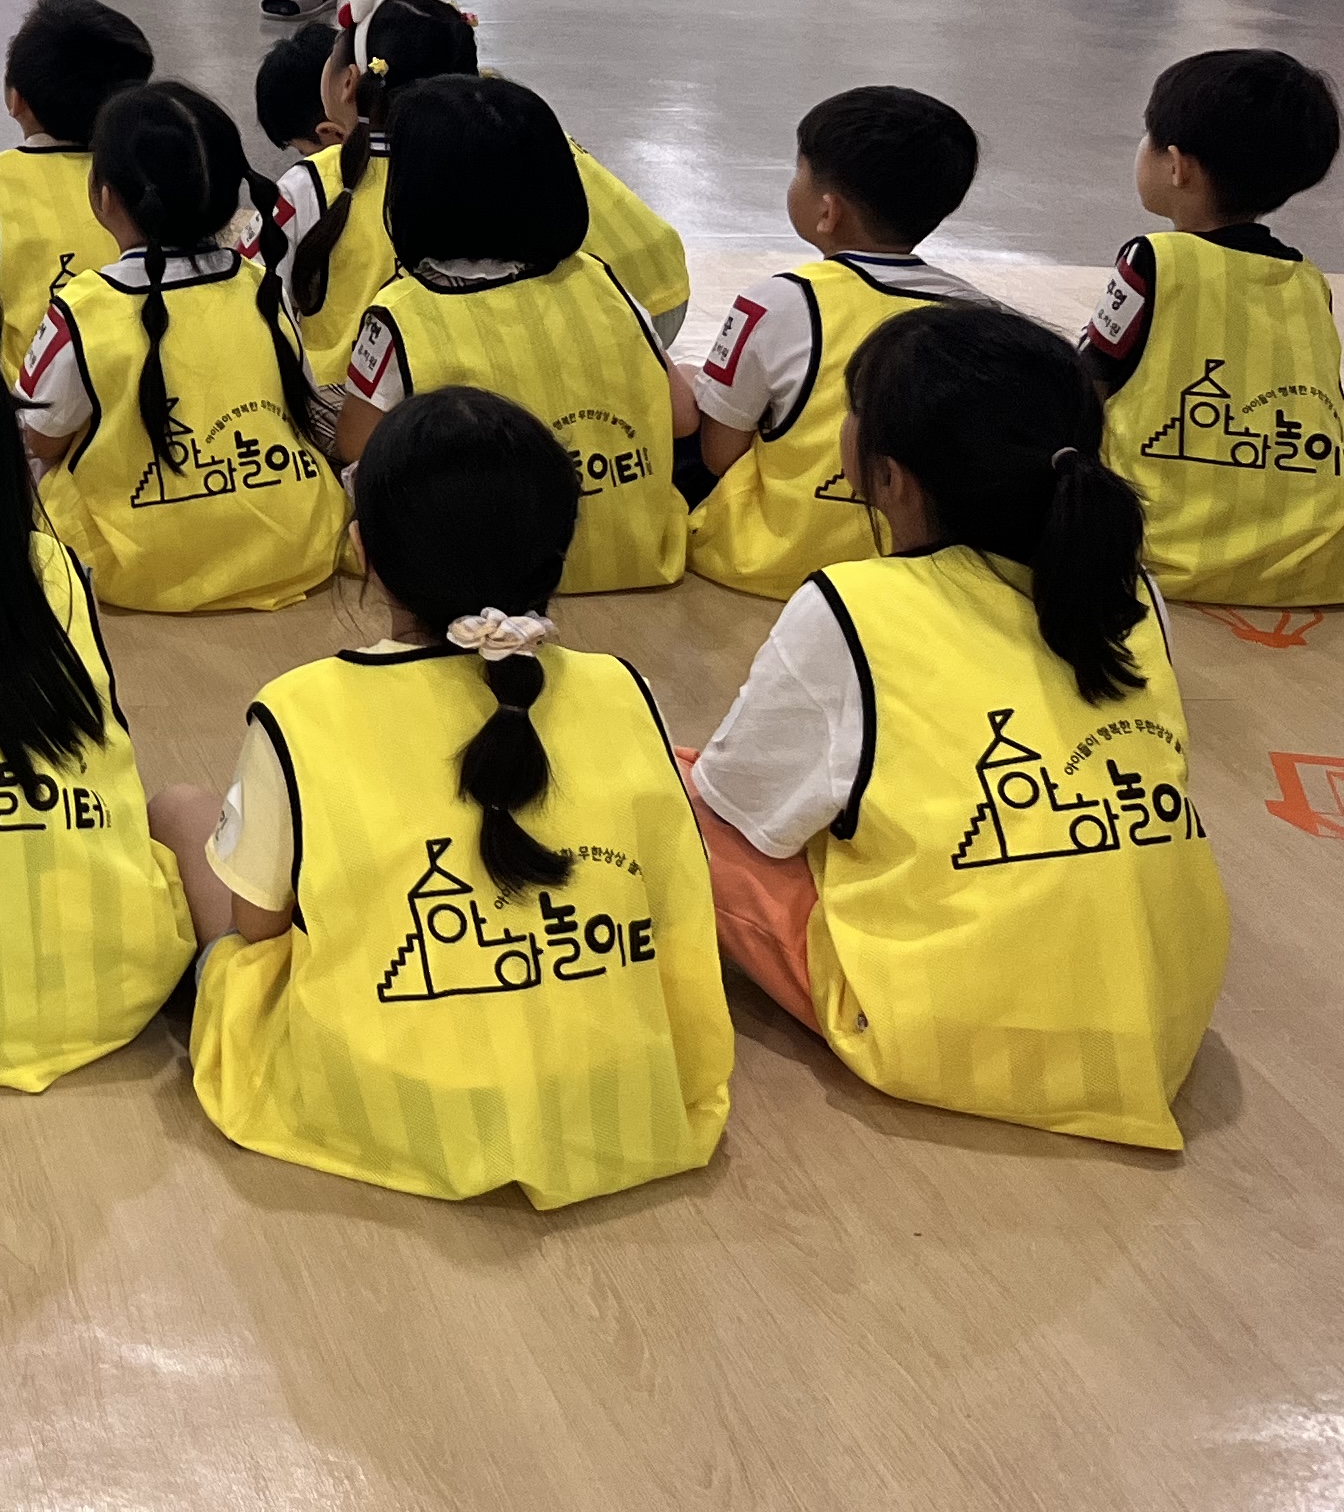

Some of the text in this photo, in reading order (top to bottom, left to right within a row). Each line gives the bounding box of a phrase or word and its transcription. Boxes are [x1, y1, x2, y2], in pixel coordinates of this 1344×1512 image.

[1064, 733, 1102, 777] 아이들이
[1095, 719, 1133, 742] 행복한
[578, 845, 629, 868] 무한상상
